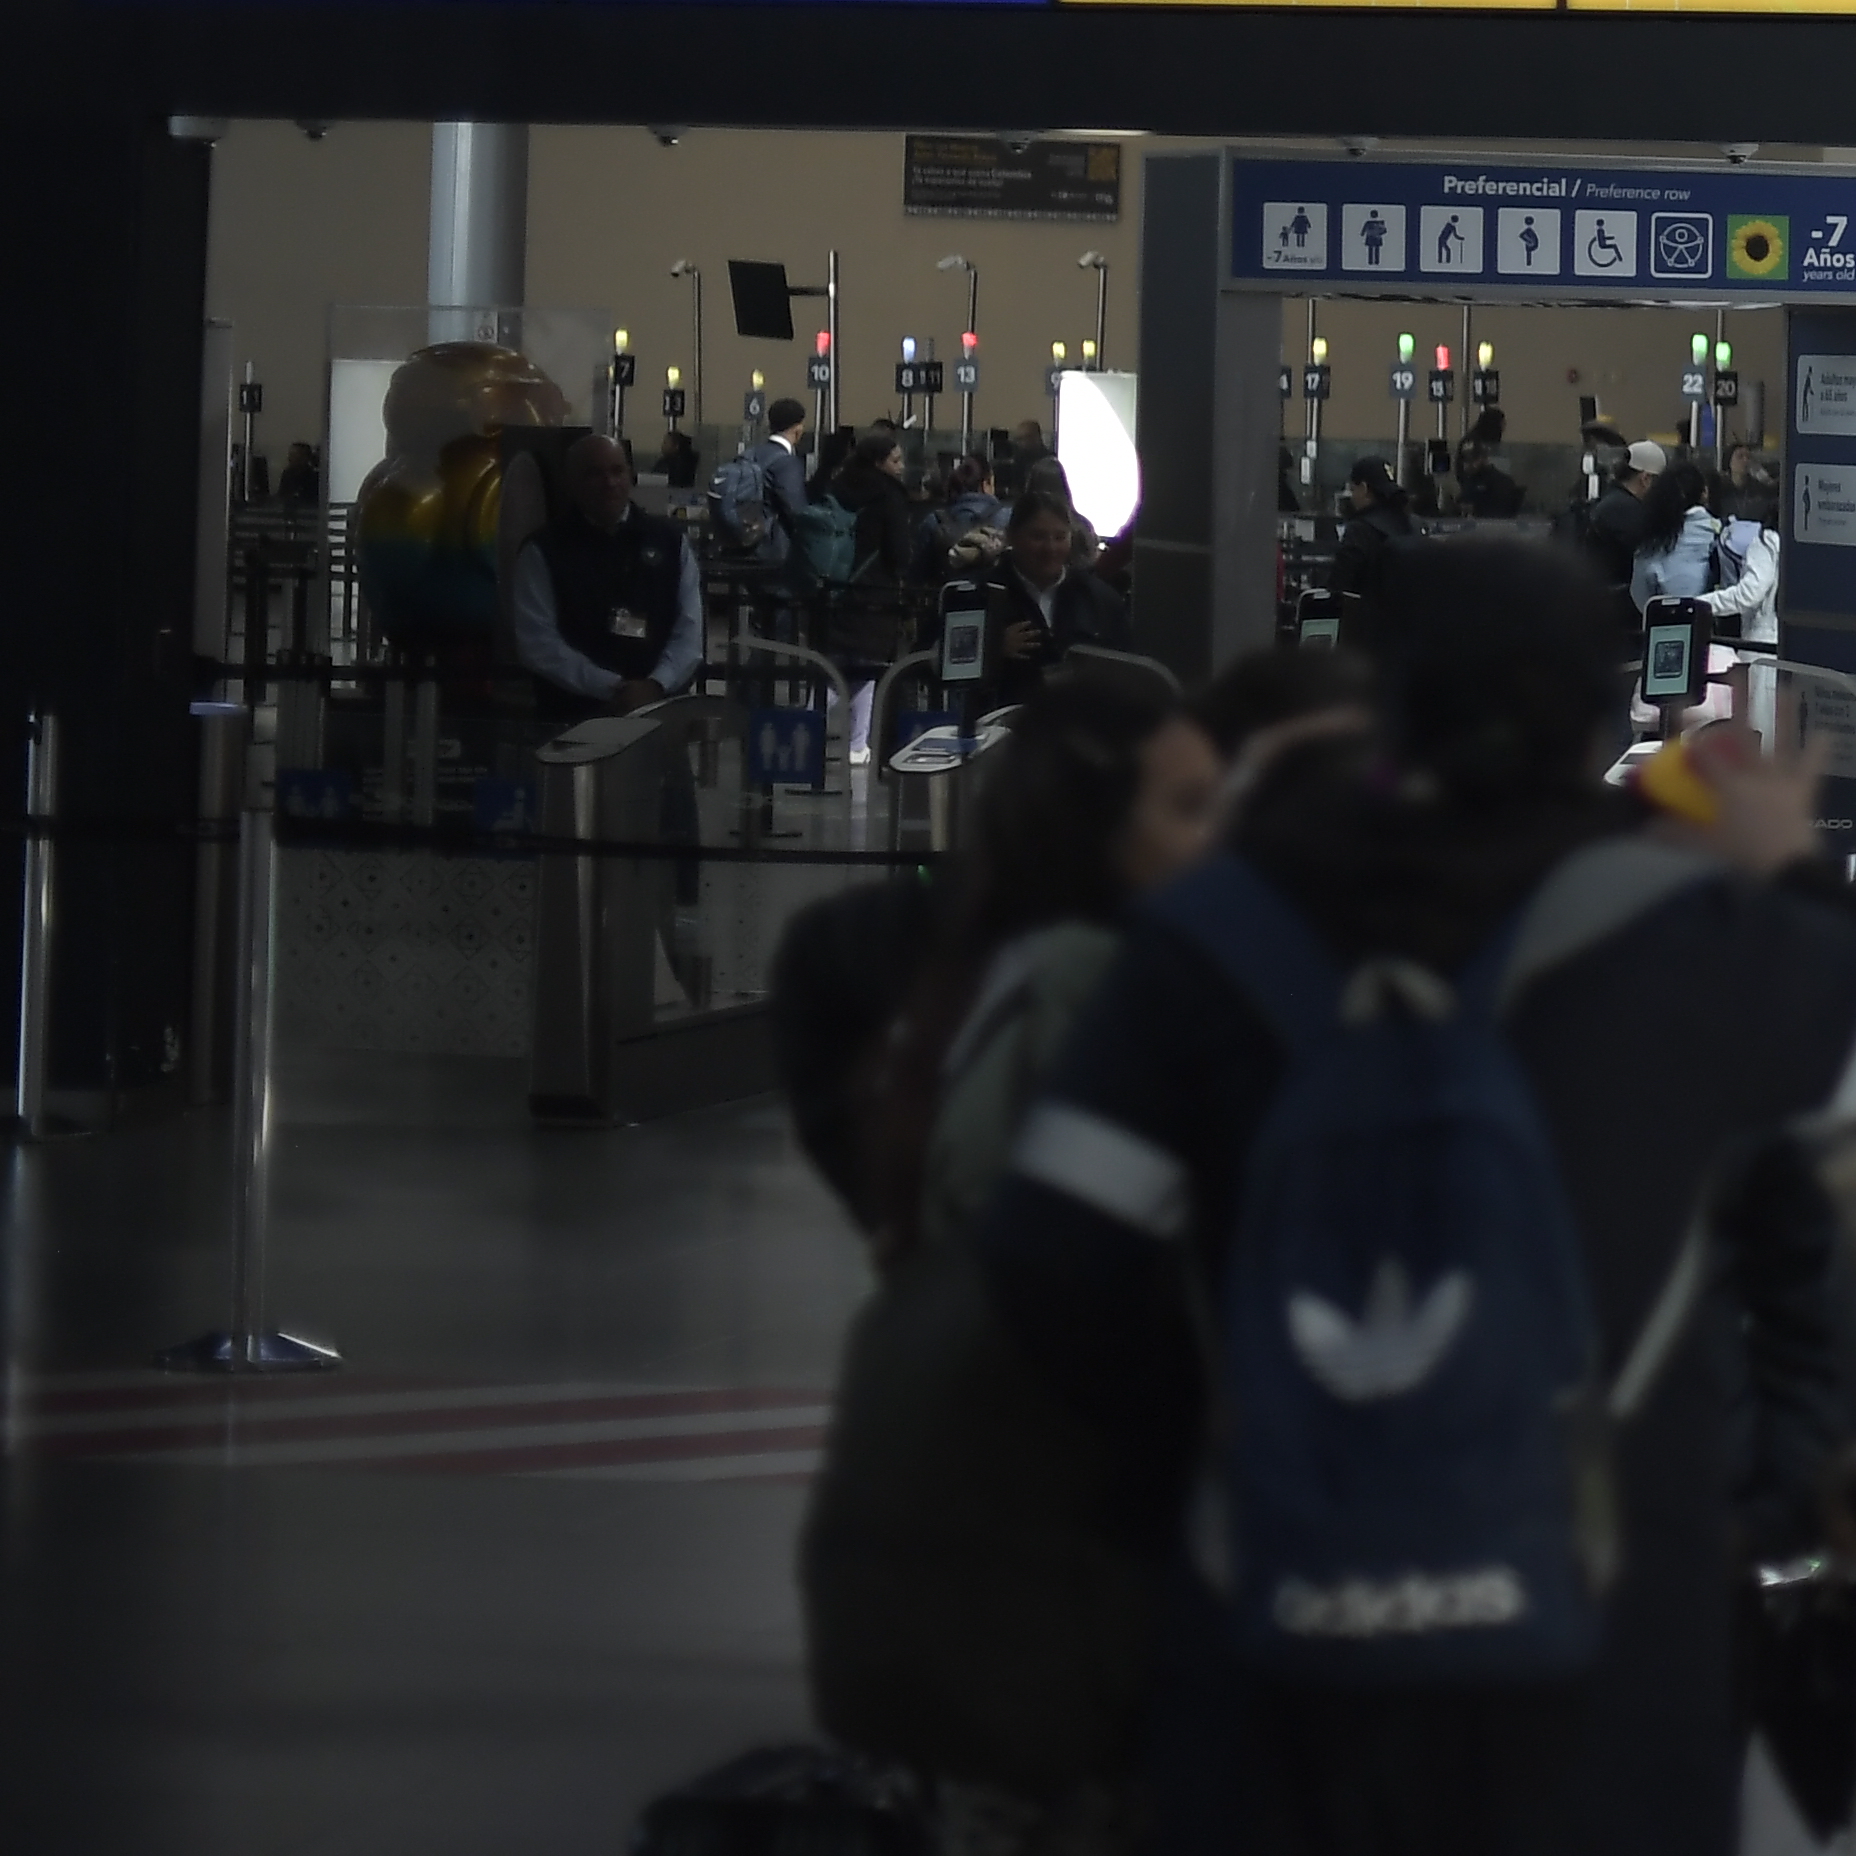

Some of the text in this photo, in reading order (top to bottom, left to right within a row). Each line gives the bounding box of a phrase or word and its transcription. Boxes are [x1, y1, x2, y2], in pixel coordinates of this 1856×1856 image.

[1443, 175, 1691, 202] Preferencial / Preference row
[1810, 215, 1848, 246] -7
[1803, 247, 1855, 269] Años
[1802, 269, 1855, 283] years old
[811, 364, 830, 381] 10
[901, 368, 914, 387] 8
[957, 365, 976, 383] 13
[1392, 370, 1414, 391] 19
[1682, 373, 1704, 395] 22
[1716, 379, 1736, 398] 20
[749, 397, 760, 415] 6
